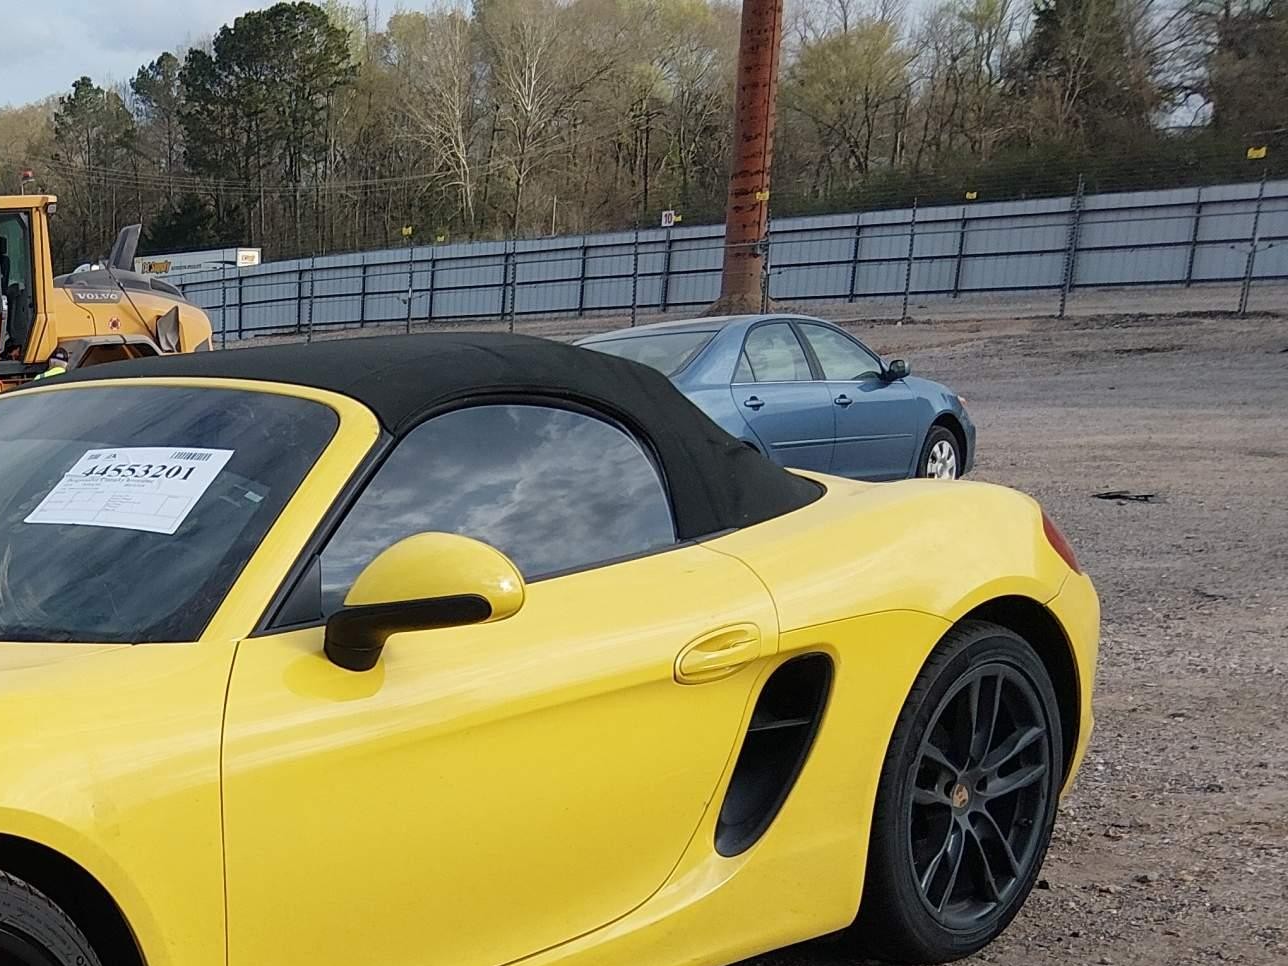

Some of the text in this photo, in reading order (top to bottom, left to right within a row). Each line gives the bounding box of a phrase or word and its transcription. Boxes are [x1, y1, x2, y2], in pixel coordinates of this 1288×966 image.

[664, 212, 673, 225] 10
[75, 292, 118, 300] VOLVO
[82, 463, 196, 481] 44553201
